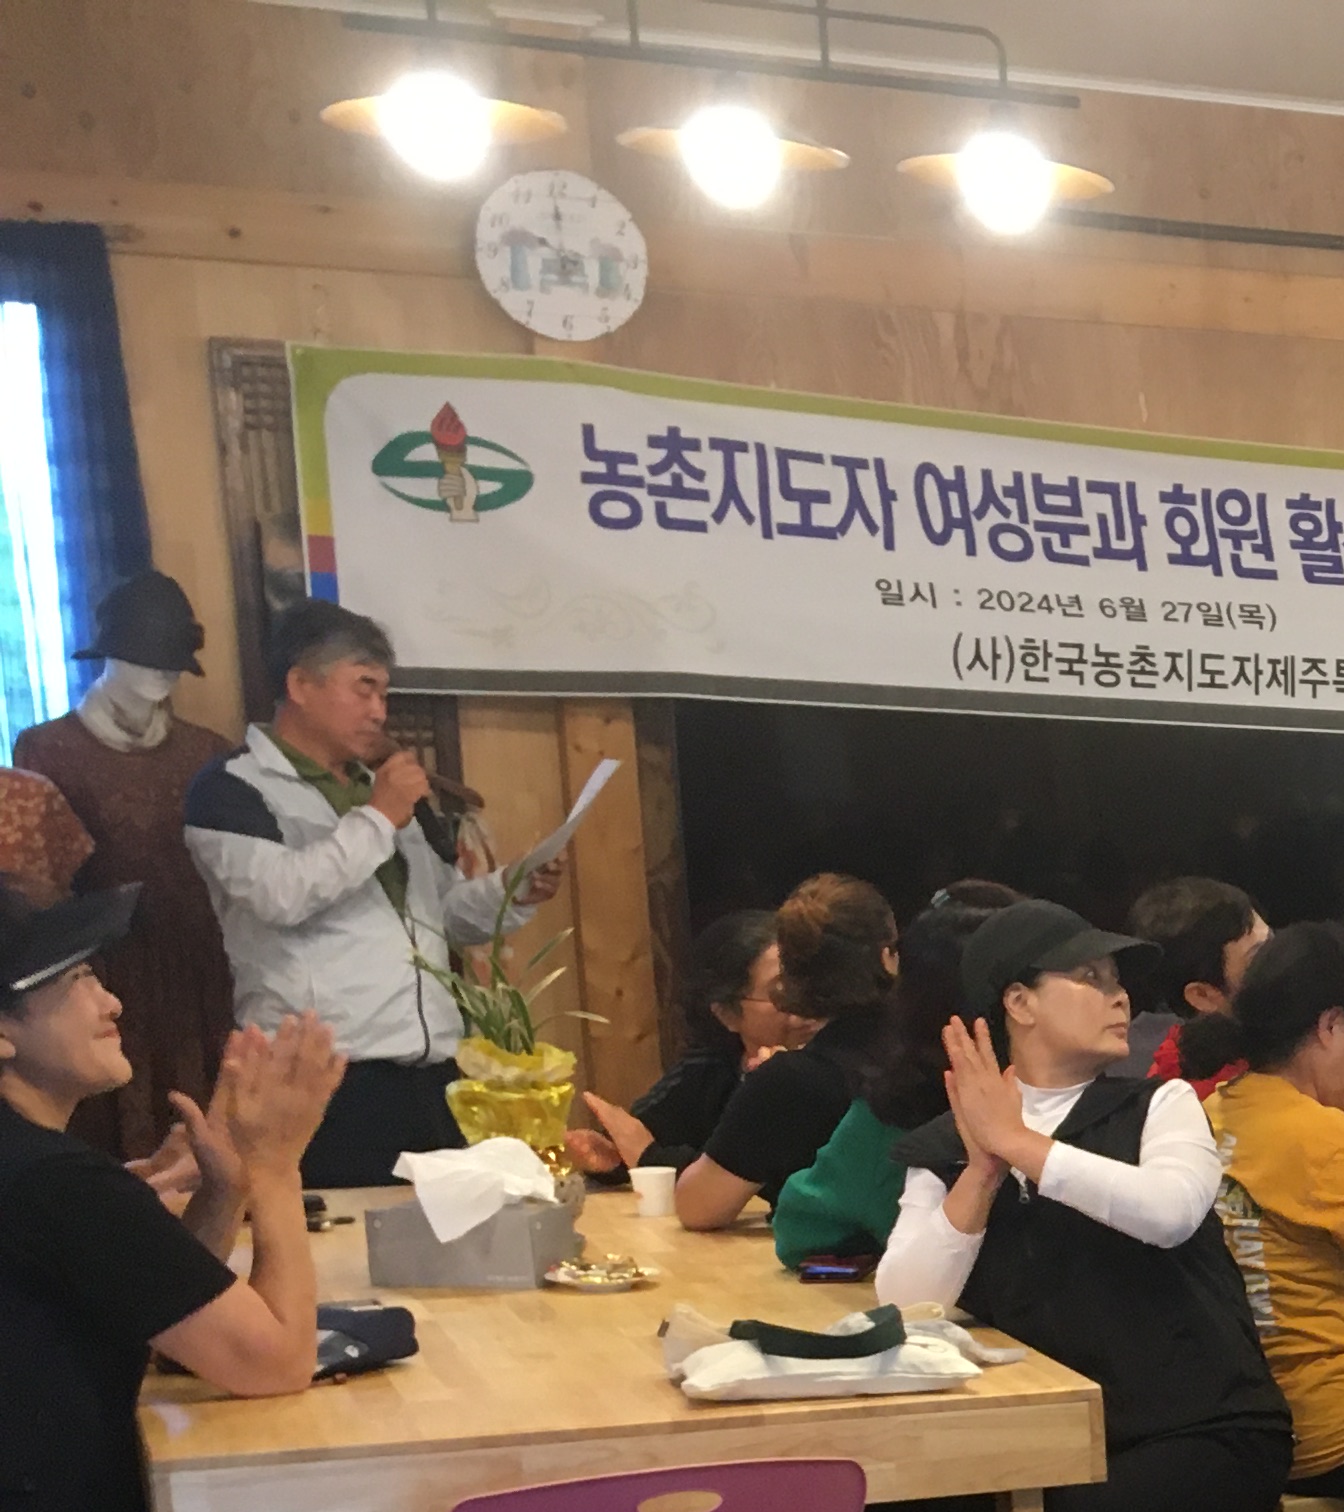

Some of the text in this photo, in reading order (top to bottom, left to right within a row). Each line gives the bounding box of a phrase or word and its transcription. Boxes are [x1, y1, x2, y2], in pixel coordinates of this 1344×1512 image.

[616, 221, 626, 236] 2
[527, 300, 535, 317] 7
[562, 315, 574, 331] 6
[579, 422, 898, 551] 농촌지도자
[913, 460, 1149, 572] 여성분과
[1157, 482, 1279, 581] 회원
[874, 577, 938, 609] 일시
[977, 588, 1086, 618] 2024년
[1099, 596, 1149, 623] 6월
[1161, 600, 1278, 632] 27일(목)
